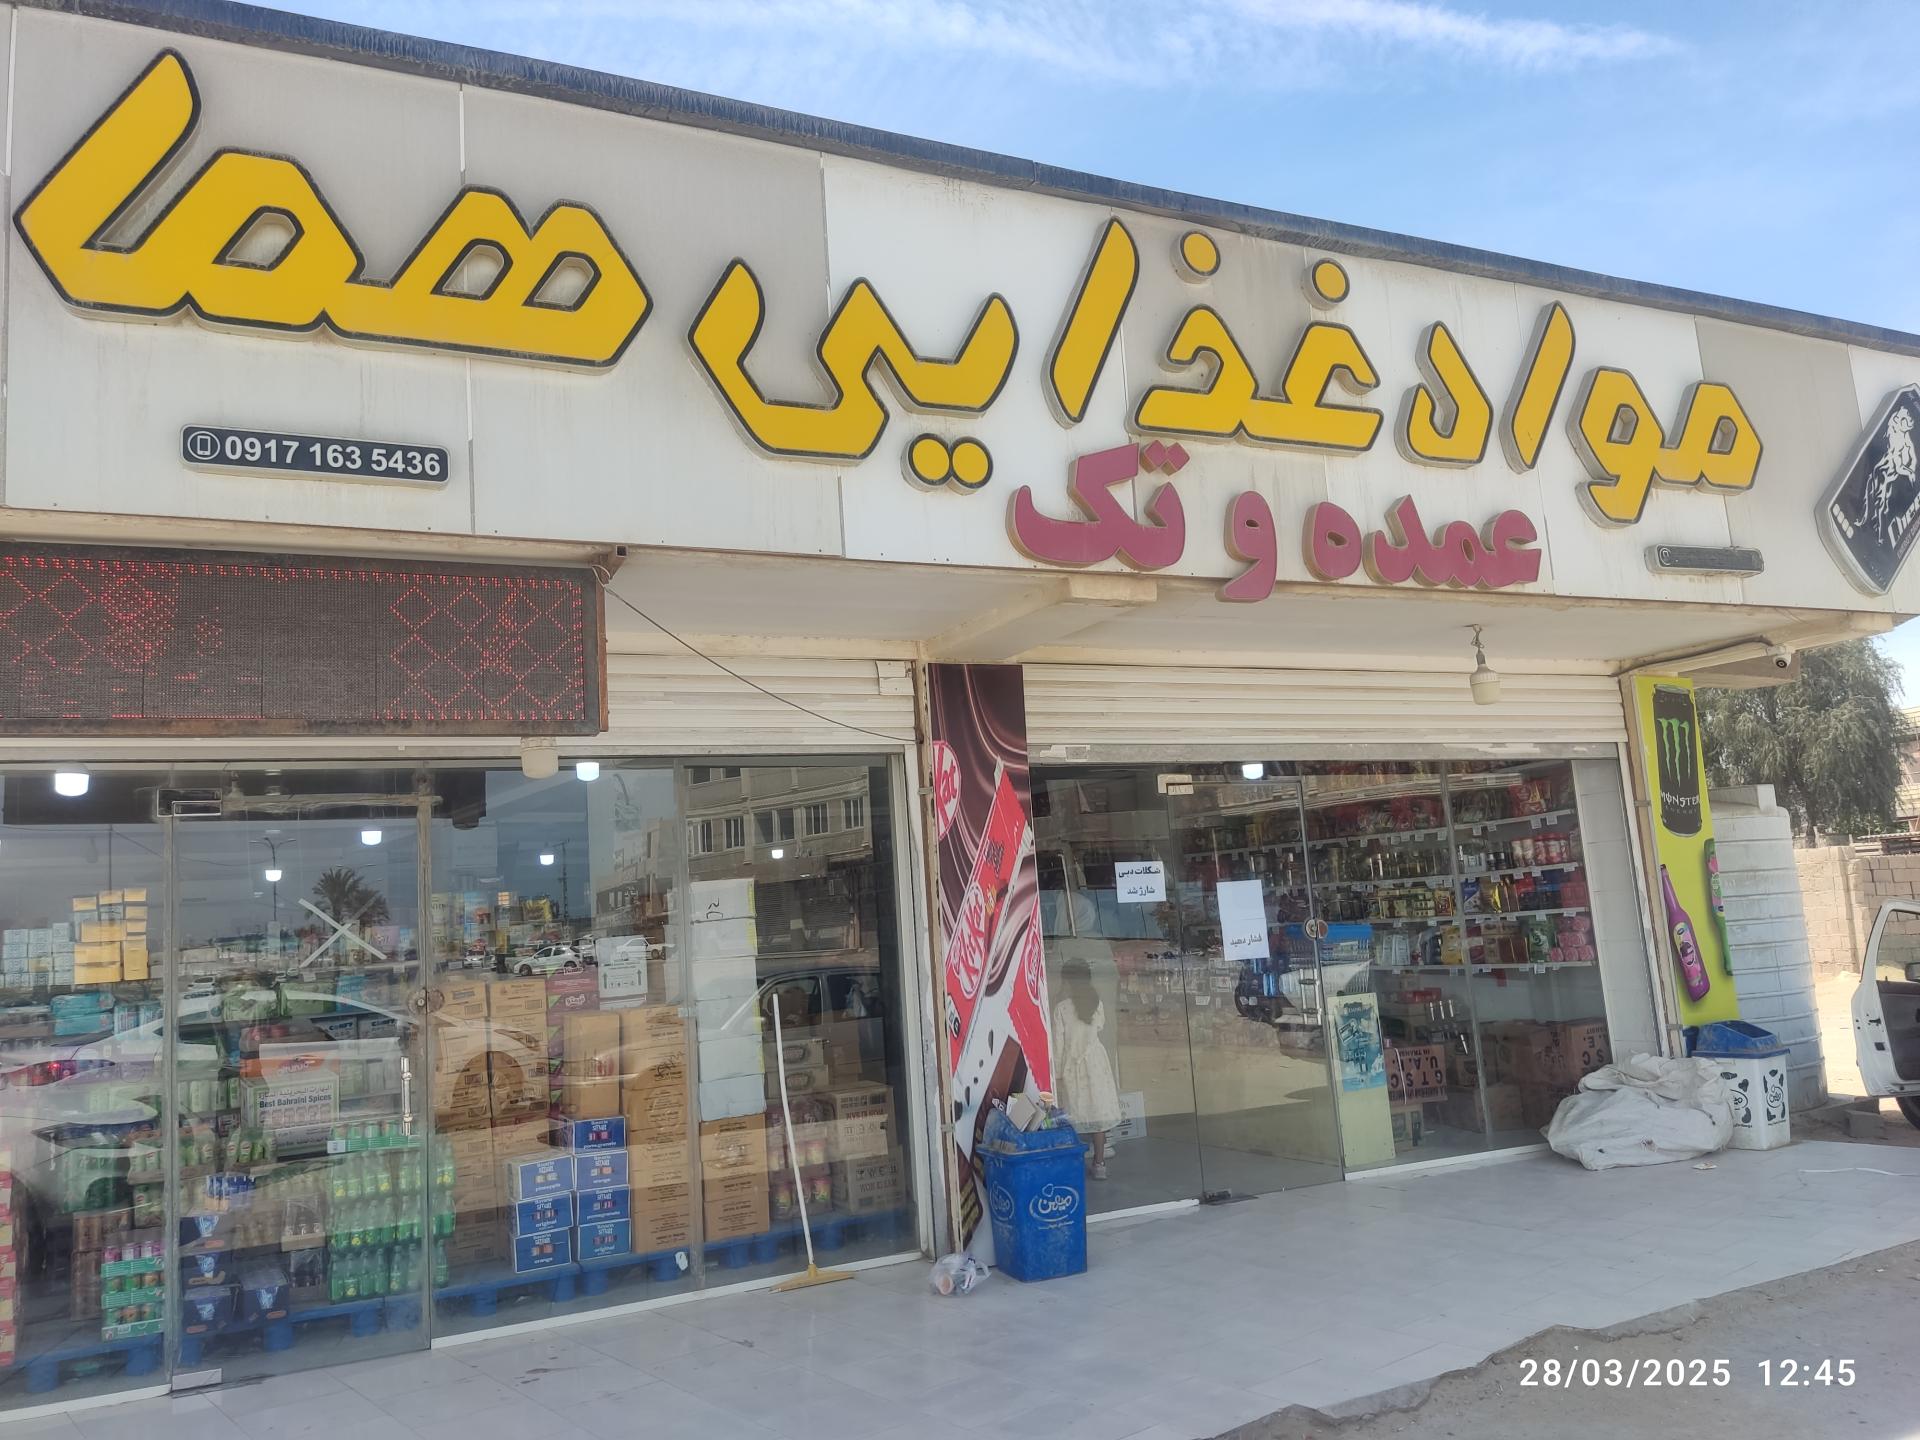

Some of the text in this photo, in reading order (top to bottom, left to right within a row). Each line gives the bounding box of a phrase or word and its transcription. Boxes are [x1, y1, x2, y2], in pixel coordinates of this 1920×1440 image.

[15, 49, 1764, 525] مواد غذایی هما
[225, 436, 441, 476] 0917 163 5436
[1006, 439, 1541, 601] عمده و تک
[259, 1093, 332, 1109] Best Bahraini Spices
